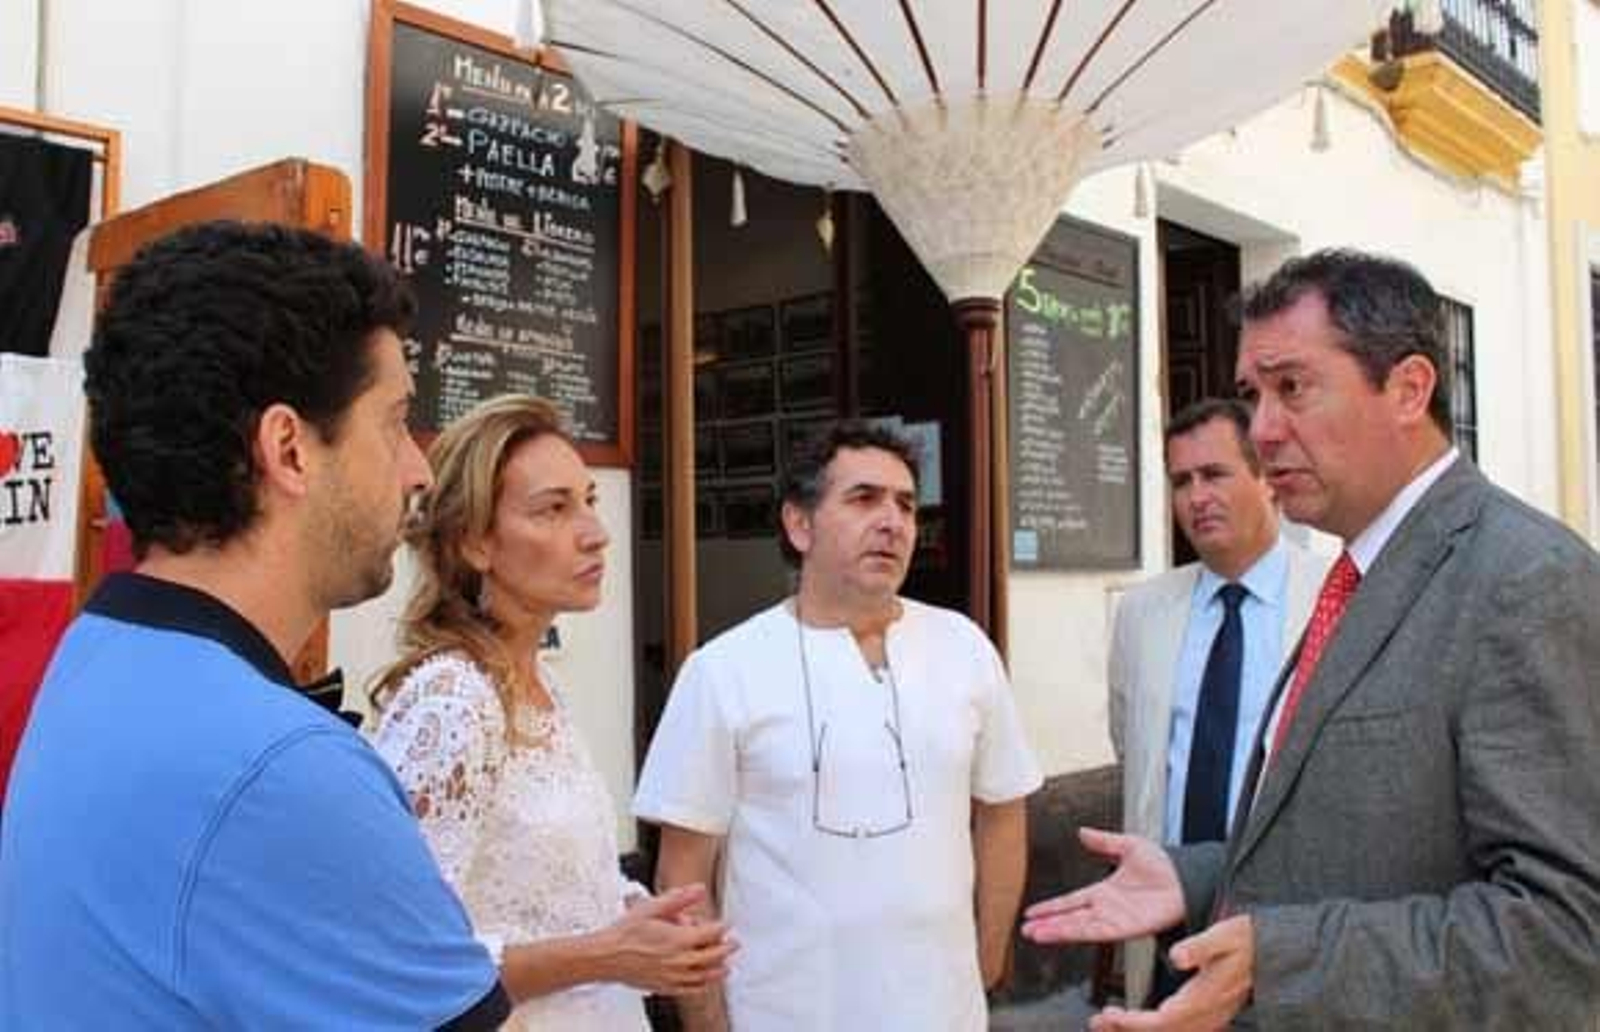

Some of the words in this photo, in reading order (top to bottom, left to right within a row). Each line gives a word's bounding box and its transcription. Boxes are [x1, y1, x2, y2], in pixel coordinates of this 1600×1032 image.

[552, 83, 573, 113] 2
[467, 130, 555, 177] PAELLA
[0, 477, 52, 525] IN
